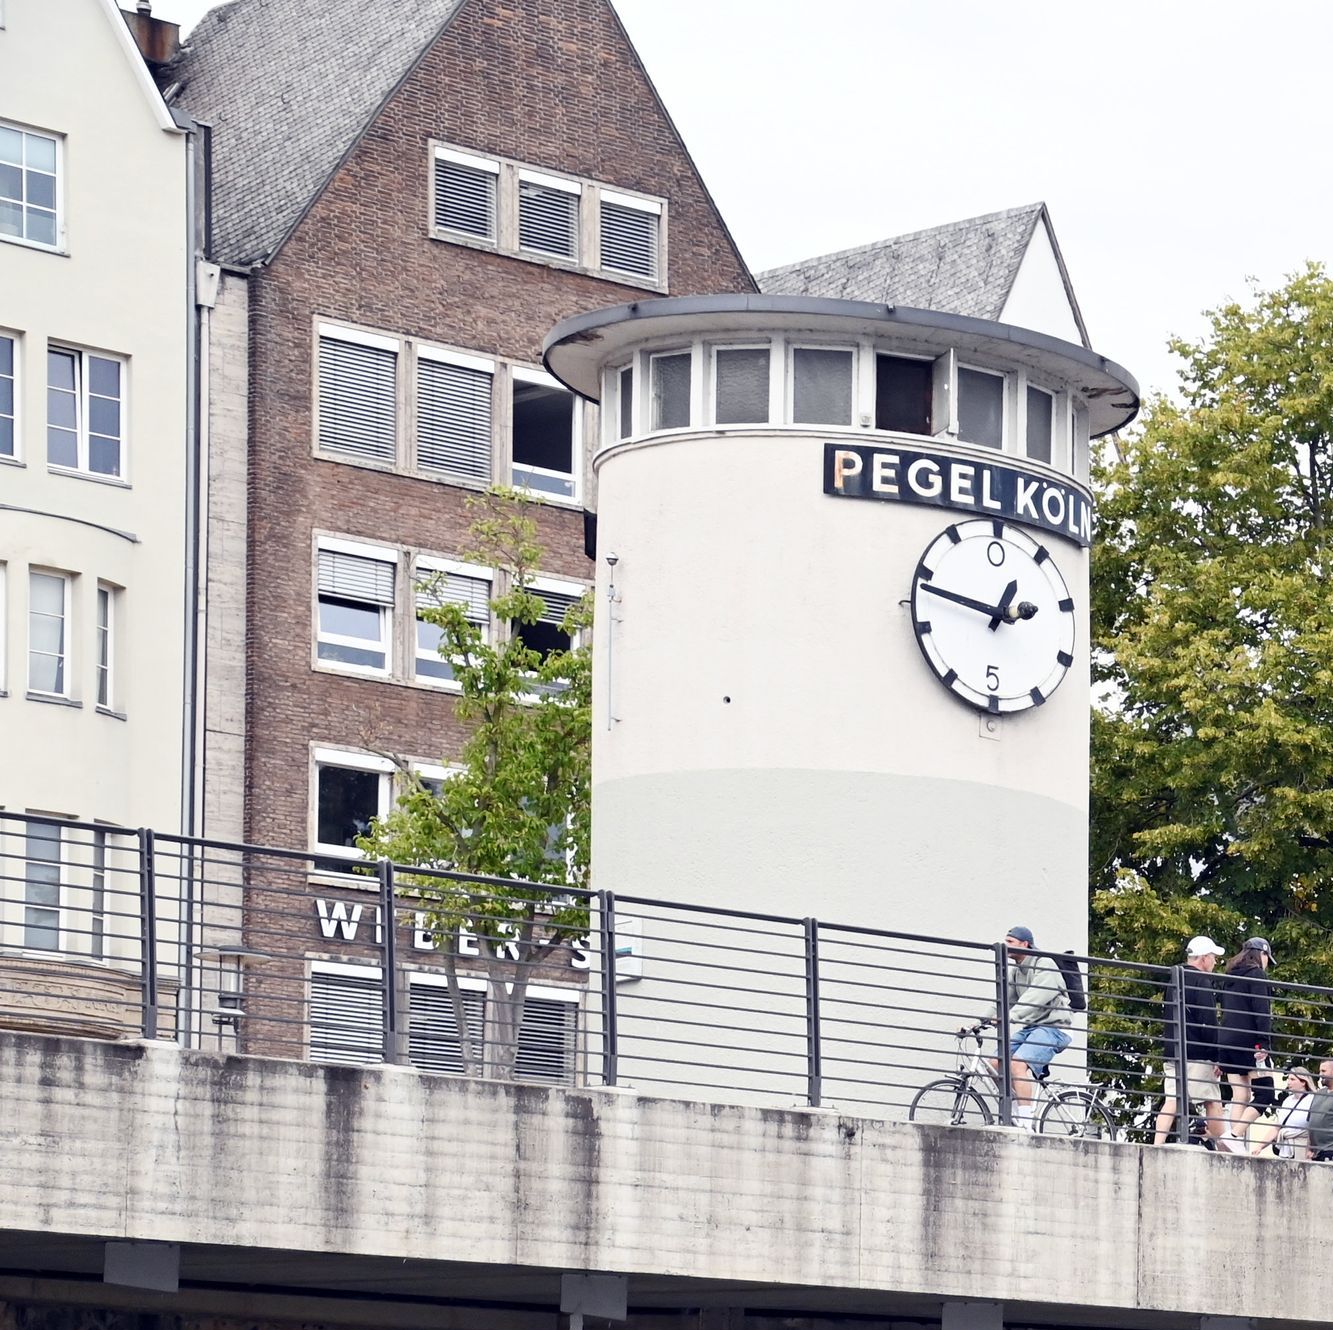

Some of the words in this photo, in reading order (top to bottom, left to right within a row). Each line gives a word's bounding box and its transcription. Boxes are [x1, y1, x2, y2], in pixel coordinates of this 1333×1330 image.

[834, 450, 1002, 510] PEGEL
[1017, 477, 1092, 543] KÖLN
[986, 665, 1000, 691] 5
